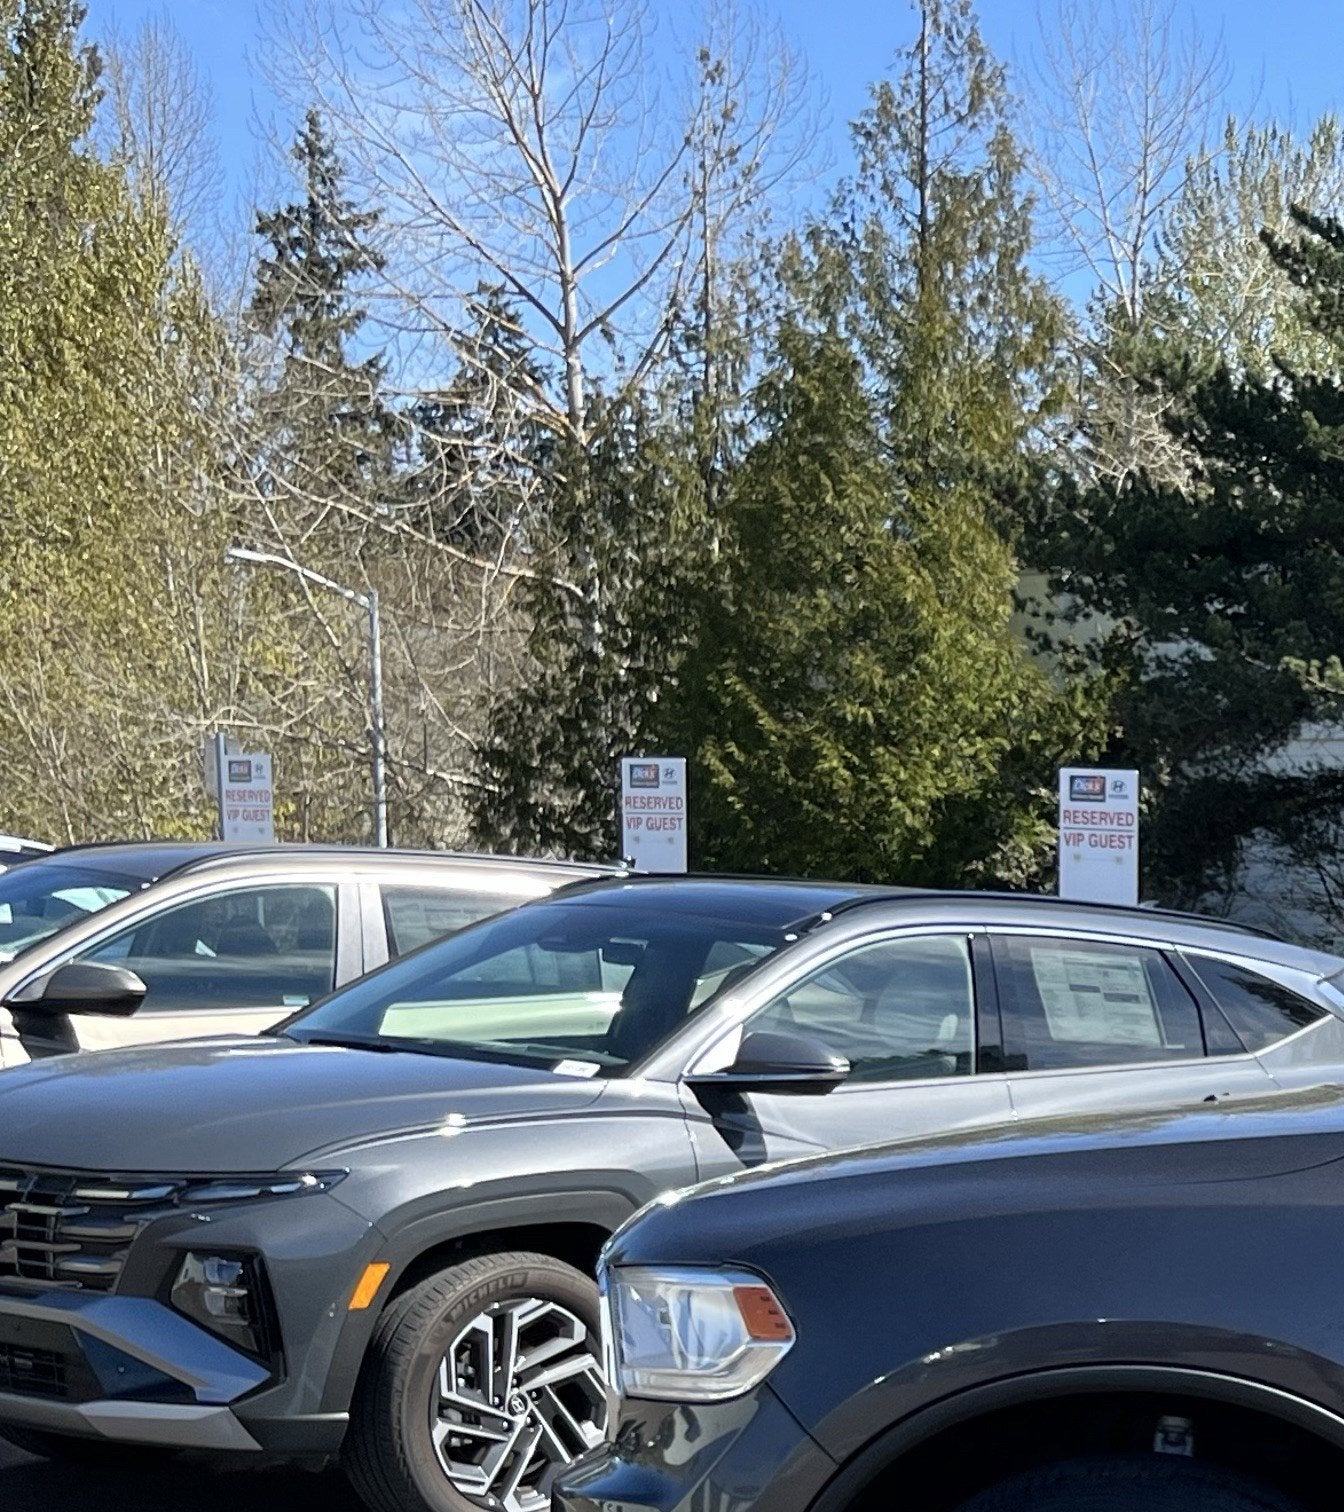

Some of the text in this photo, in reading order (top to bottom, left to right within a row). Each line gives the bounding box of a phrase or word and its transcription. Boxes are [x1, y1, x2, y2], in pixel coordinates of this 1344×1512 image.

[225, 789, 271, 803] RESERVED
[625, 795, 684, 810] RESERVED
[626, 816, 684, 831] VIP GUEST
[1063, 809, 1135, 827] RESERVED
[1063, 832, 1135, 849] VIP GUEST
